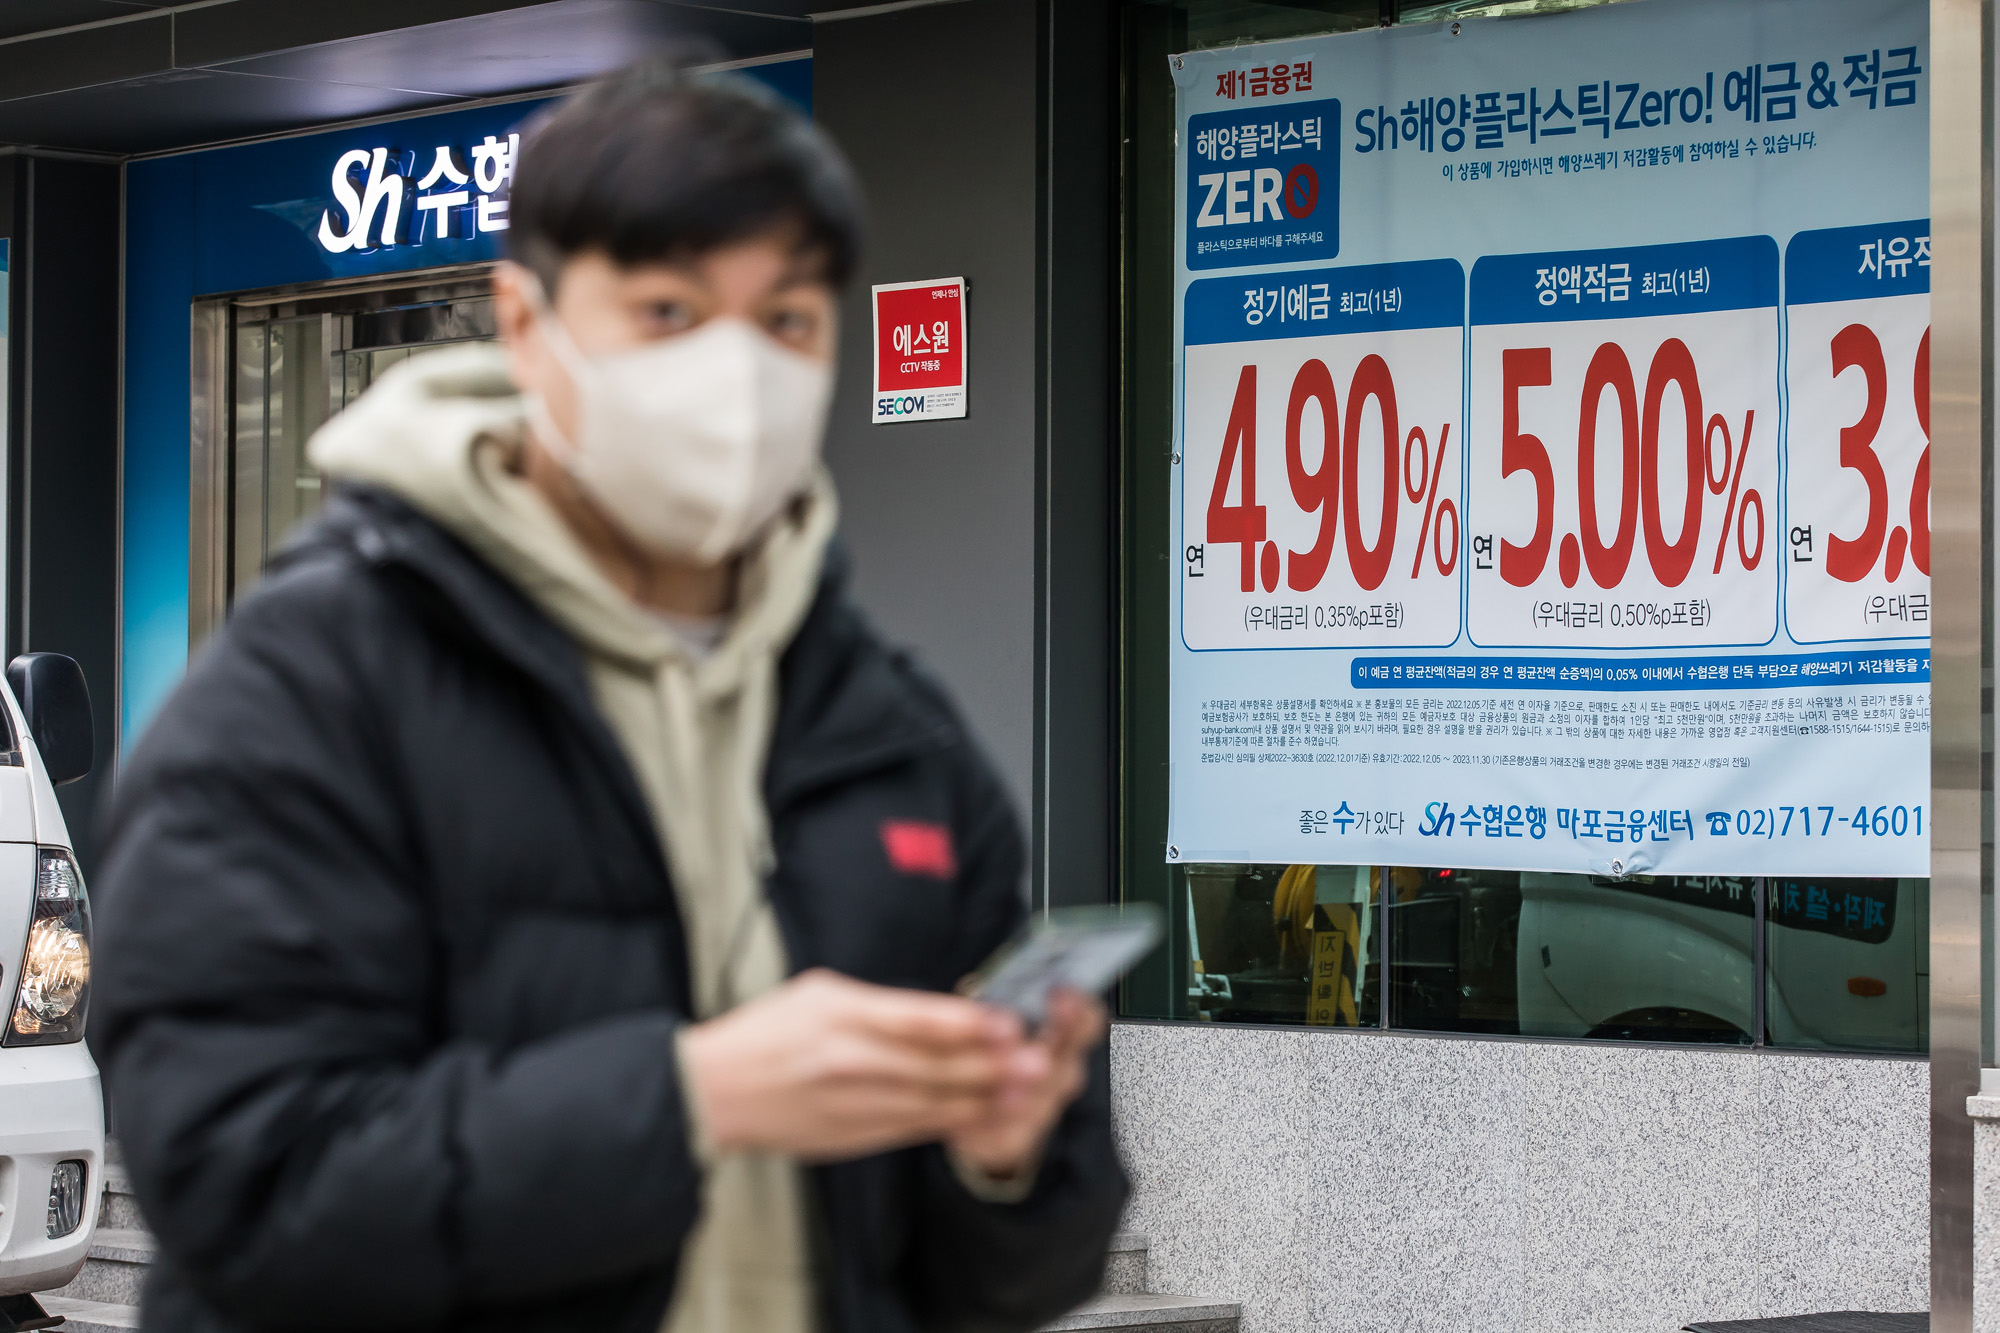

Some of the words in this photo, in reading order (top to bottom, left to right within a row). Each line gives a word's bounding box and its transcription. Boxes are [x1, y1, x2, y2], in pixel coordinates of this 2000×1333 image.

[1216, 61, 1312, 99] 제1금융권
[1355, 72, 1714, 153] Sh해양플라스틱Zero!
[1197, 117, 1322, 161] 해양플라스틱
[1443, 164, 1453, 181] 이
[1458, 161, 1491, 181] 상품에
[1497, 157, 1553, 177] 가입하시면
[1558, 151, 1618, 173] 해양쓰레기
[1623, 145, 1684, 167] 저감활동에
[1689, 139, 1739, 162] 참여하실
[1745, 138, 1758, 156] 수
[1763, 132, 1817, 154] 있습니다.
[1197, 236, 1258, 254] 플라스틱으로부터
[1260, 234, 1283, 248] 바다를
[1285, 231, 1324, 246] 구해주세요
[931, 289, 947, 300] 언제나
[1535, 262, 1632, 306] 정액적금
[1641, 266, 1711, 296] 최고(1년)
[1243, 284, 1331, 325] 정기예금
[1340, 287, 1402, 315] 최고(1년)
[893, 321, 949, 357] 에스원
[900, 361, 920, 374] CCTV
[921, 360, 941, 372] 작동중
[877, 396, 925, 416] SECOM
[1186, 543, 1204, 578] 연
[1207, 354, 1459, 593] 4.90%
[1473, 533, 1493, 570] 연
[1500, 337, 1764, 589] 5.00%
[1790, 524, 1812, 562] 연
[1244, 605, 1308, 631] (우대금리
[1315, 601, 1404, 631] 0.35%p포함)
[1533, 601, 1603, 628] (우대금리
[1610, 599, 1711, 629] 0.50%p포함)
[1358, 666, 1367, 679] 이
[1370, 665, 1390, 679] 예금
[1392, 665, 1402, 679] 연
[1405, 665, 1476, 680] 평균잔액(적금의
[1480, 666, 1499, 680] 경우
[1503, 666, 1513, 680] 연
[1517, 666, 1556, 680] 평균잔액
[1559, 666, 1603, 681] 순증액)의
[1606, 668, 1638, 681] 0.05%
[1642, 666, 1684, 681] 이내에서
[1687, 665, 1729, 680] 수협은행
[1732, 665, 1754, 679] 단독
[1758, 664, 1798, 679] 부담으로
[1801, 660, 1853, 676] 해양쓰레기
[1857, 658, 1918, 674] 저감활동을
[1210, 699, 1237, 710] 우대금리
[1239, 699, 1273, 710] 세부항목은
[1275, 699, 1316, 710] 상품설명서를
[1319, 699, 1354, 710] 확인하세요
[1405, 699, 1420, 710] 모든
[1422, 699, 1444, 710] 금리는
[1528, 700, 1551, 712] 이자율
[1588, 701, 1619, 713] 판매한도
[1621, 702, 1637, 712] 소진
[1640, 702, 1648, 712] 시
[1650, 702, 1667, 712] 또는
[1670, 701, 1701, 712] 판매한도
[1704, 701, 1736, 712] 내에서도
[1806, 696, 1844, 708] 사유발생
[1847, 696, 1857, 708] 시
[1860, 695, 1886, 707] 금리가
[1284, 711, 1297, 722] 보호
[1335, 711, 1356, 722] 은행에
[1359, 711, 1373, 722] 있는
[1401, 711, 1416, 722] 모든
[1420, 711, 1456, 722] 예금자보호
[1460, 711, 1475, 722] 대상
[1479, 711, 1518, 723] 금융상품의
[1521, 712, 1545, 724] 원금과
[1549, 713, 1571, 725] 소정의
[1575, 714, 1599, 726] 이자를
[1799, 710, 1827, 722] 나머지
[1831, 709, 1860, 721] 금액은
[1863, 708, 1896, 720] 보호하지
[1250, 736, 1264, 747] 따른
[1288, 736, 1302, 747] 준수
[1264, 724, 1278, 734] 상품
[1280, 724, 1302, 734] 설명서
[1353, 724, 1374, 734] 보시기
[1426, 724, 1441, 735] 경우
[1486, 724, 1509, 736] 권리가
[1555, 726, 1563, 736] 그
[1583, 727, 1607, 739] 상품에
[1609, 727, 1625, 740] 대한
[1628, 727, 1652, 740] 자세한
[1655, 727, 1677, 739] 내용은
[1680, 726, 1705, 739] 가까운
[1708, 726, 1731, 738] 영업점
[1201, 753, 1234, 763] 준법감시인
[1587, 758, 1611, 769] 변경한
[1645, 758, 1669, 770] 변경된
[1299, 810, 1329, 834] 좋은
[1557, 807, 1694, 843] 마포금융센터
